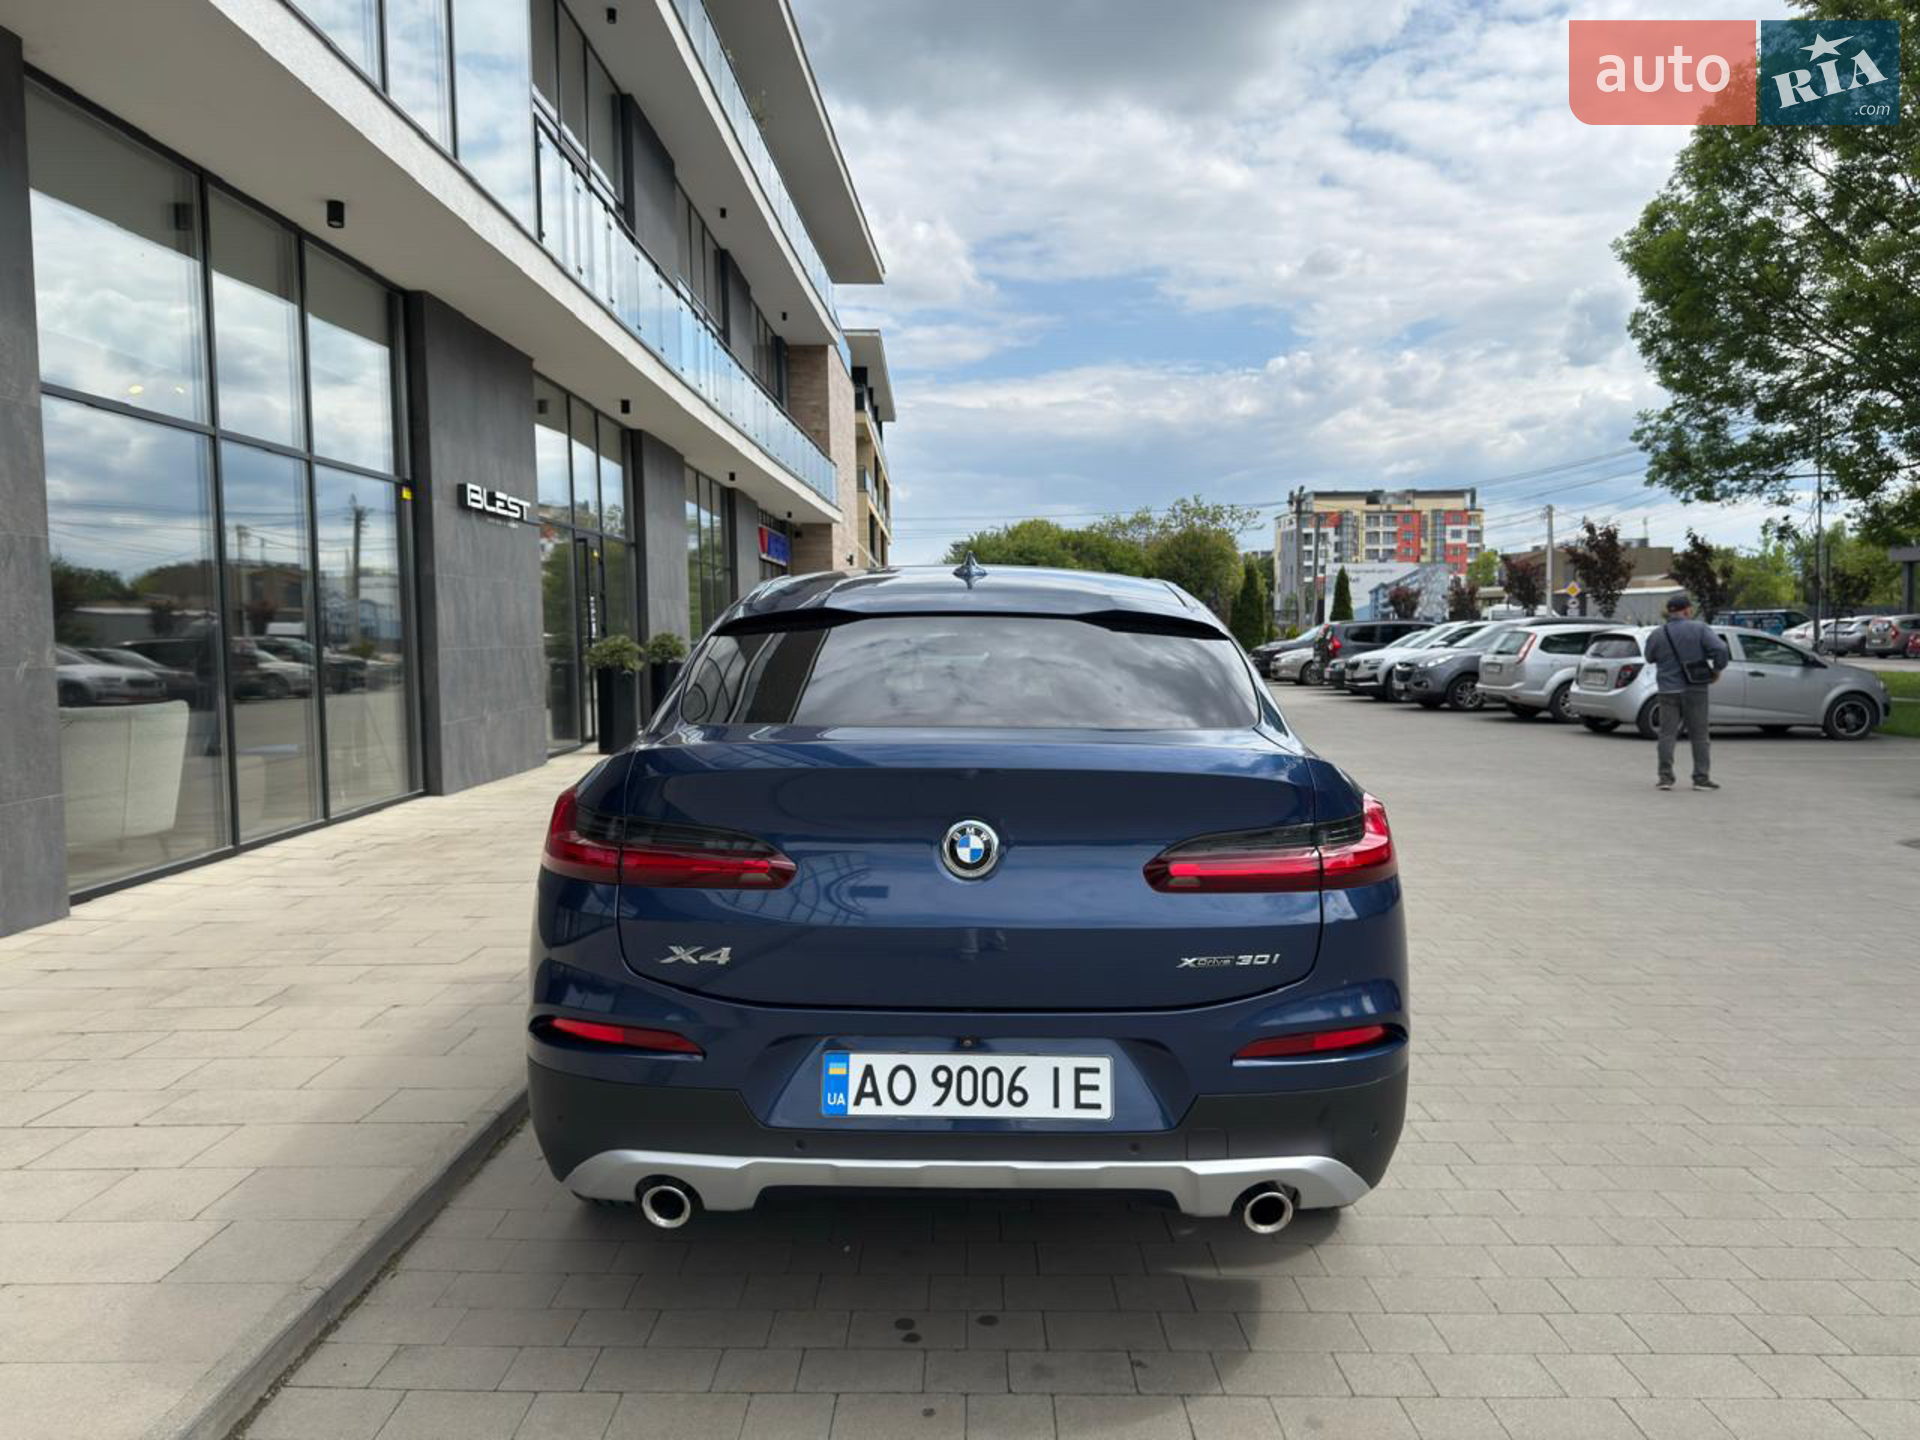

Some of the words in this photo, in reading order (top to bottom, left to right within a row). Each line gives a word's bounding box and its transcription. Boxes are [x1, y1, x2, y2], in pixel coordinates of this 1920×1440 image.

[466, 482, 531, 521] BLEST
[659, 945, 732, 965] X4
[827, 1092, 846, 1105] UA
[853, 1063, 918, 1107] AO
[931, 1064, 1030, 1108] 9006
[1052, 1066, 1102, 1110] IE
